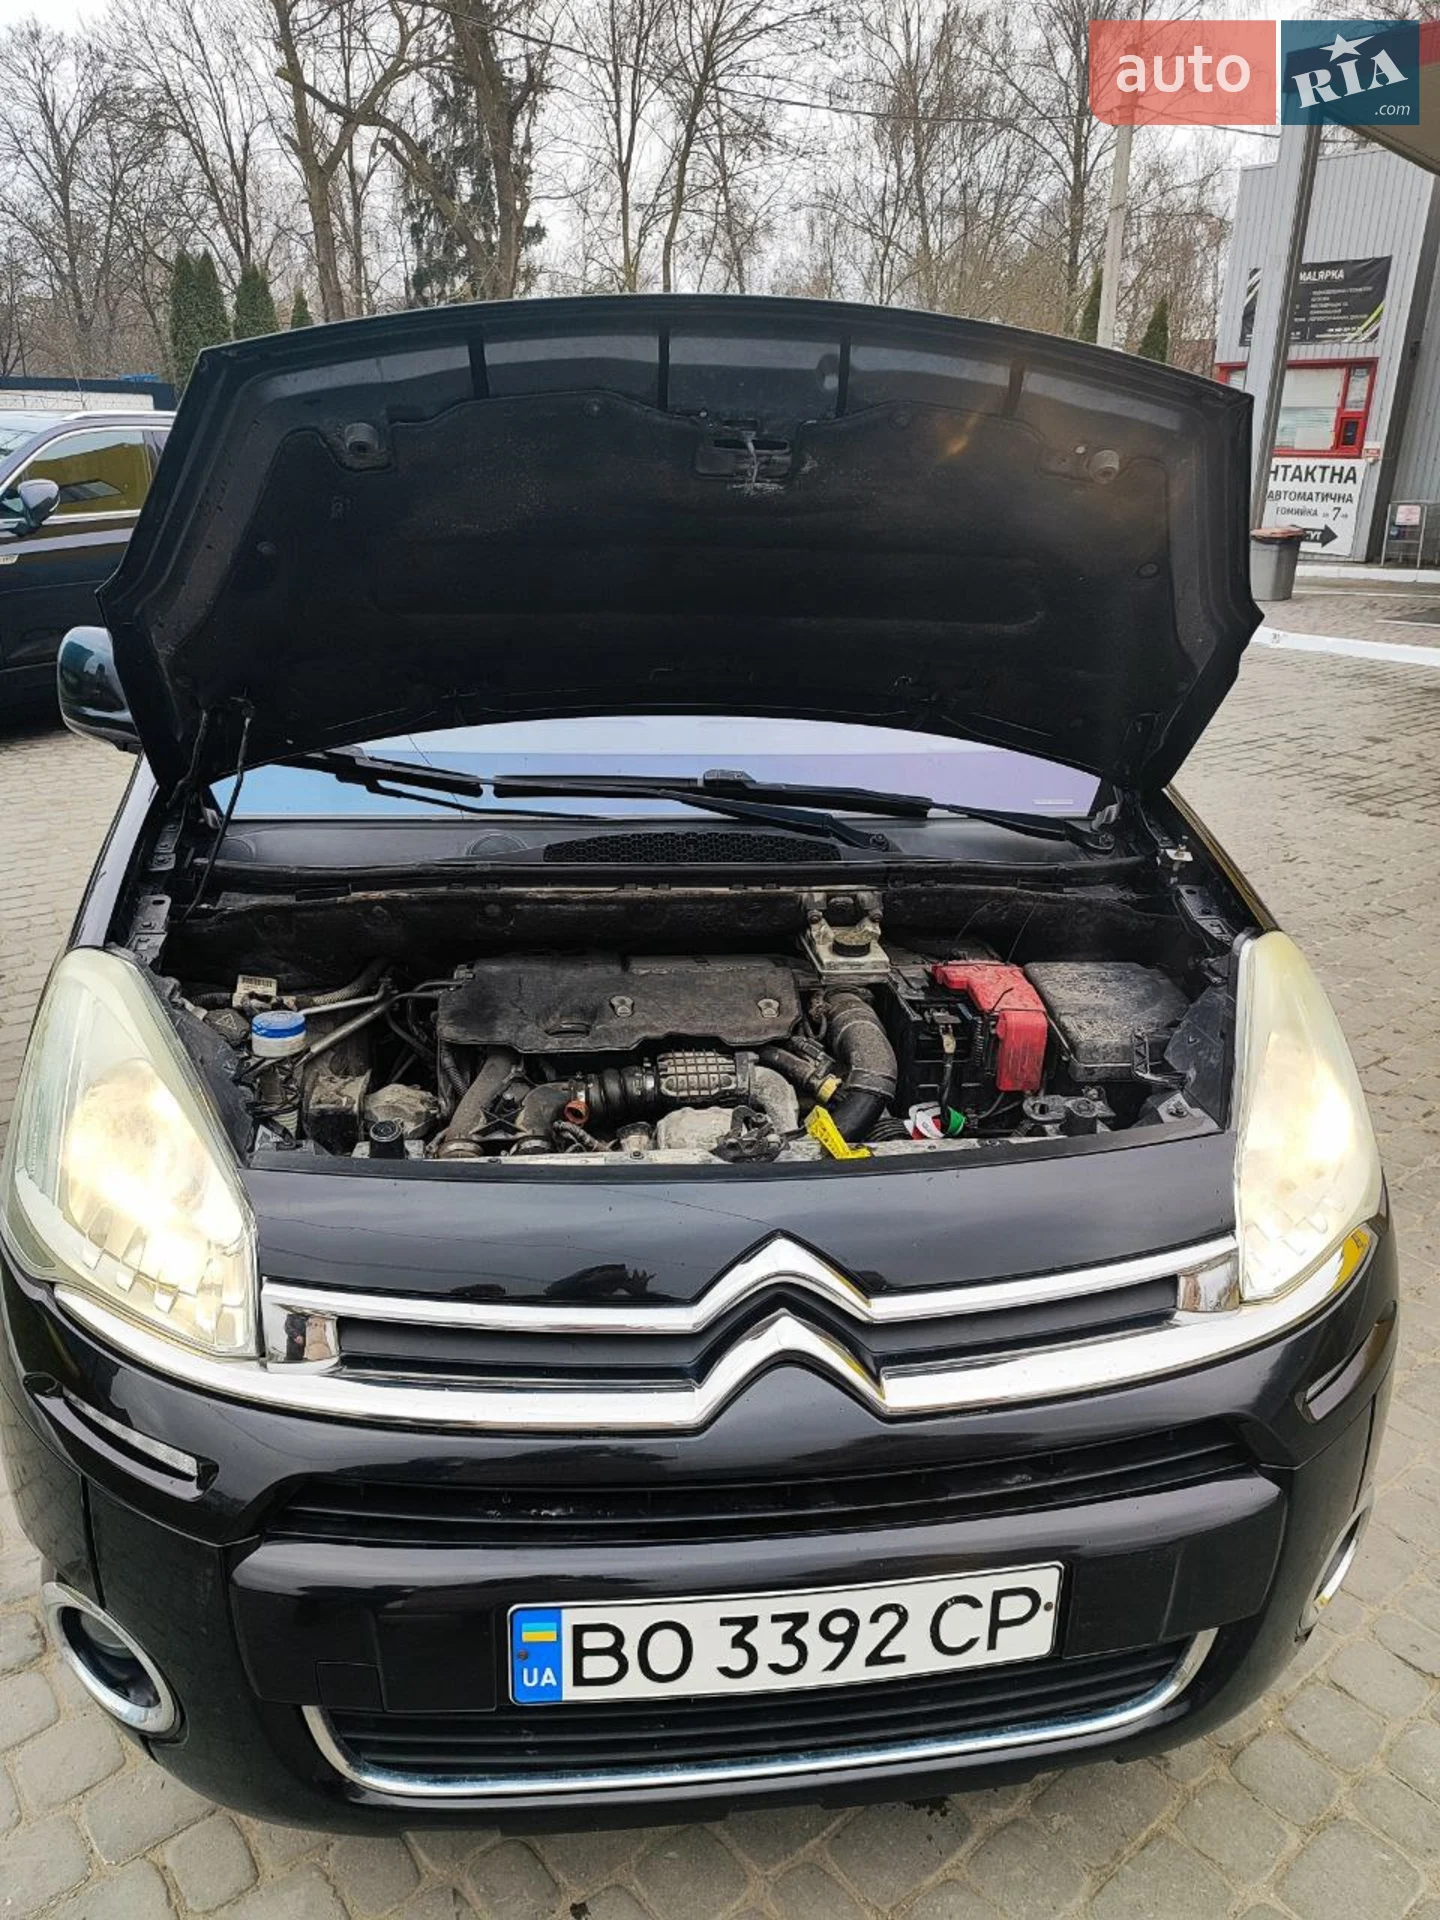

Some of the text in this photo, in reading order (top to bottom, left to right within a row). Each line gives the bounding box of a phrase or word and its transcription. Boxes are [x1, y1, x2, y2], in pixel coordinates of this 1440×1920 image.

[1267, 489, 1354, 504] АВТОМАТИЧНА
[1332, 506, 1342, 521] 7
[571, 1586, 1042, 1687] BO 3392 CP
[521, 1668, 557, 1688] UA
